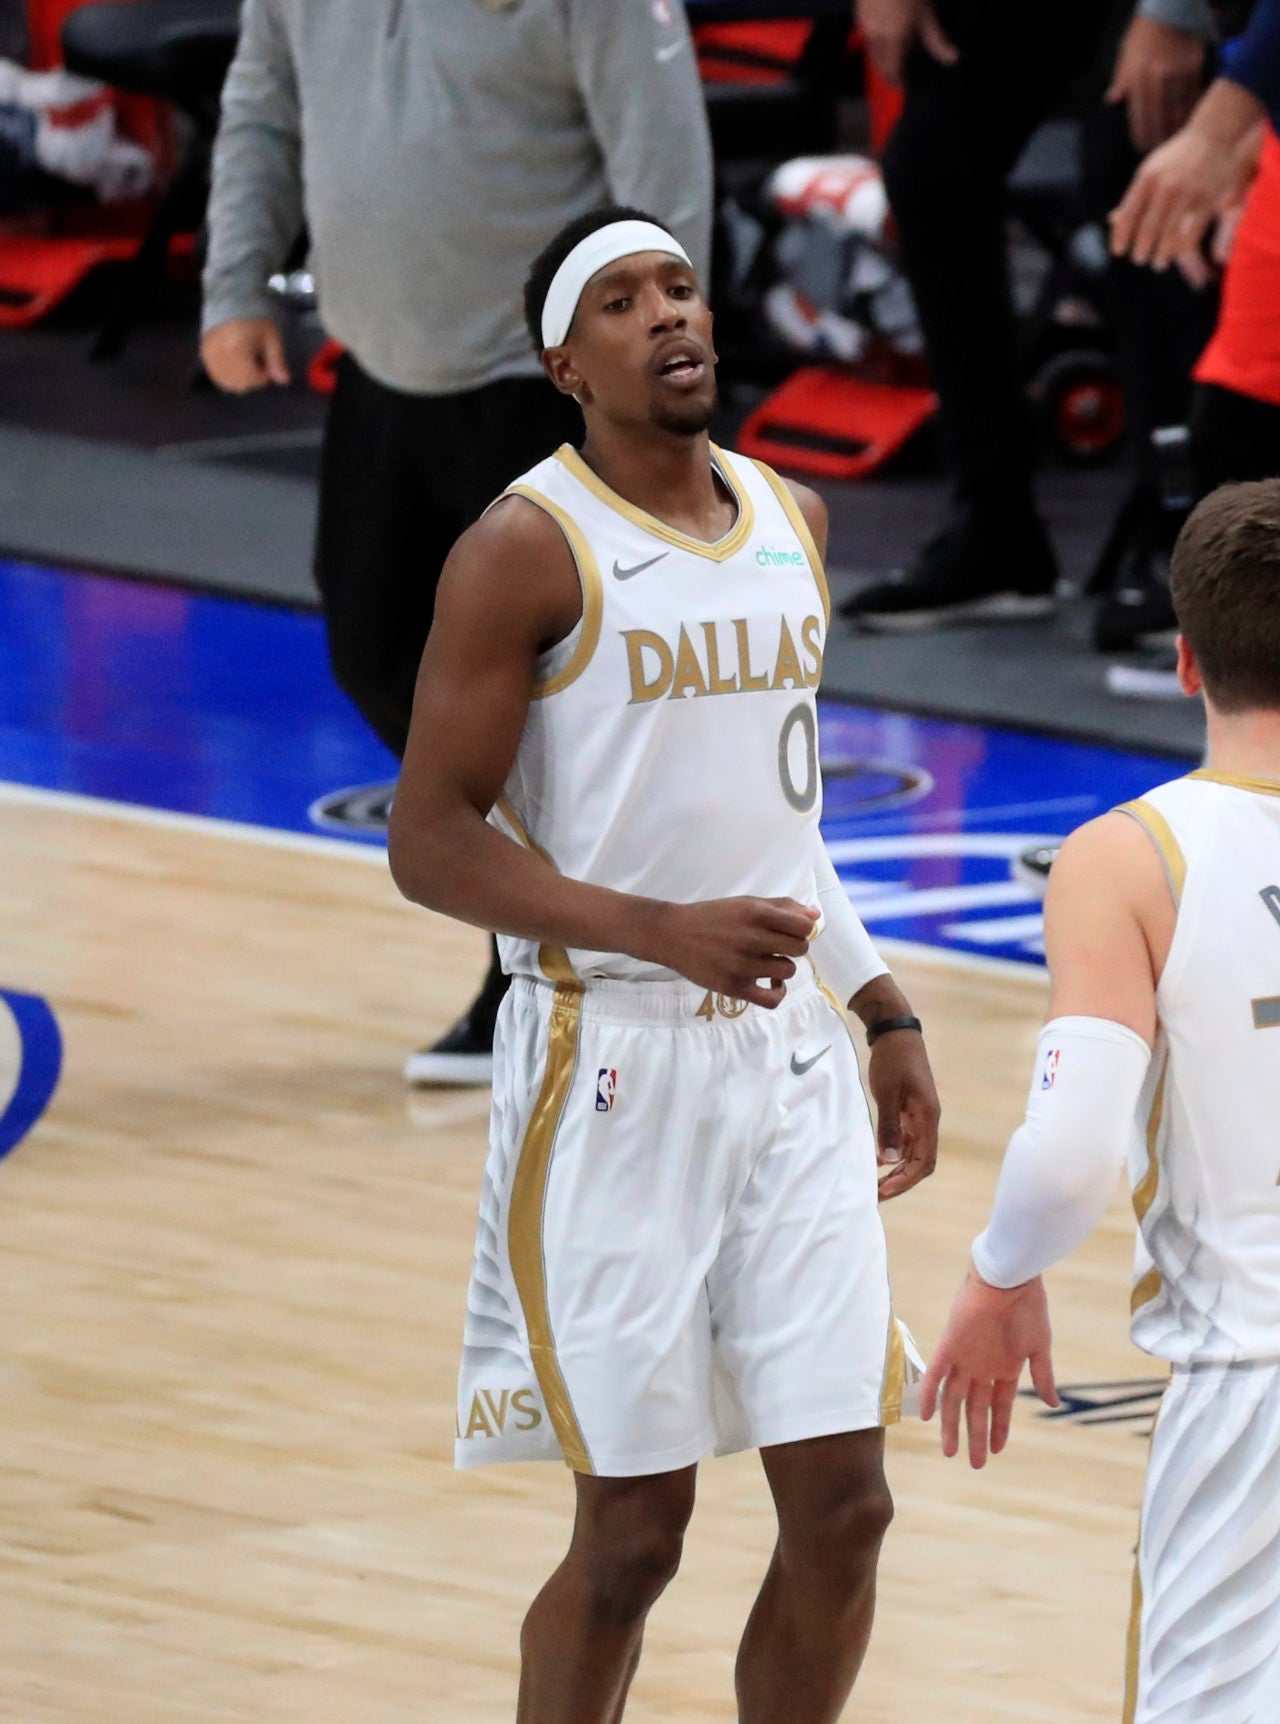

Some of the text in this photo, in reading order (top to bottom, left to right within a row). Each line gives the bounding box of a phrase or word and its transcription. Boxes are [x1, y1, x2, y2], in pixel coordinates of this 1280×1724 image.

[755, 544, 806, 567] chime
[618, 612, 823, 705] DALLAS
[778, 701, 817, 813] 0
[456, 1388, 542, 1439] AVS
